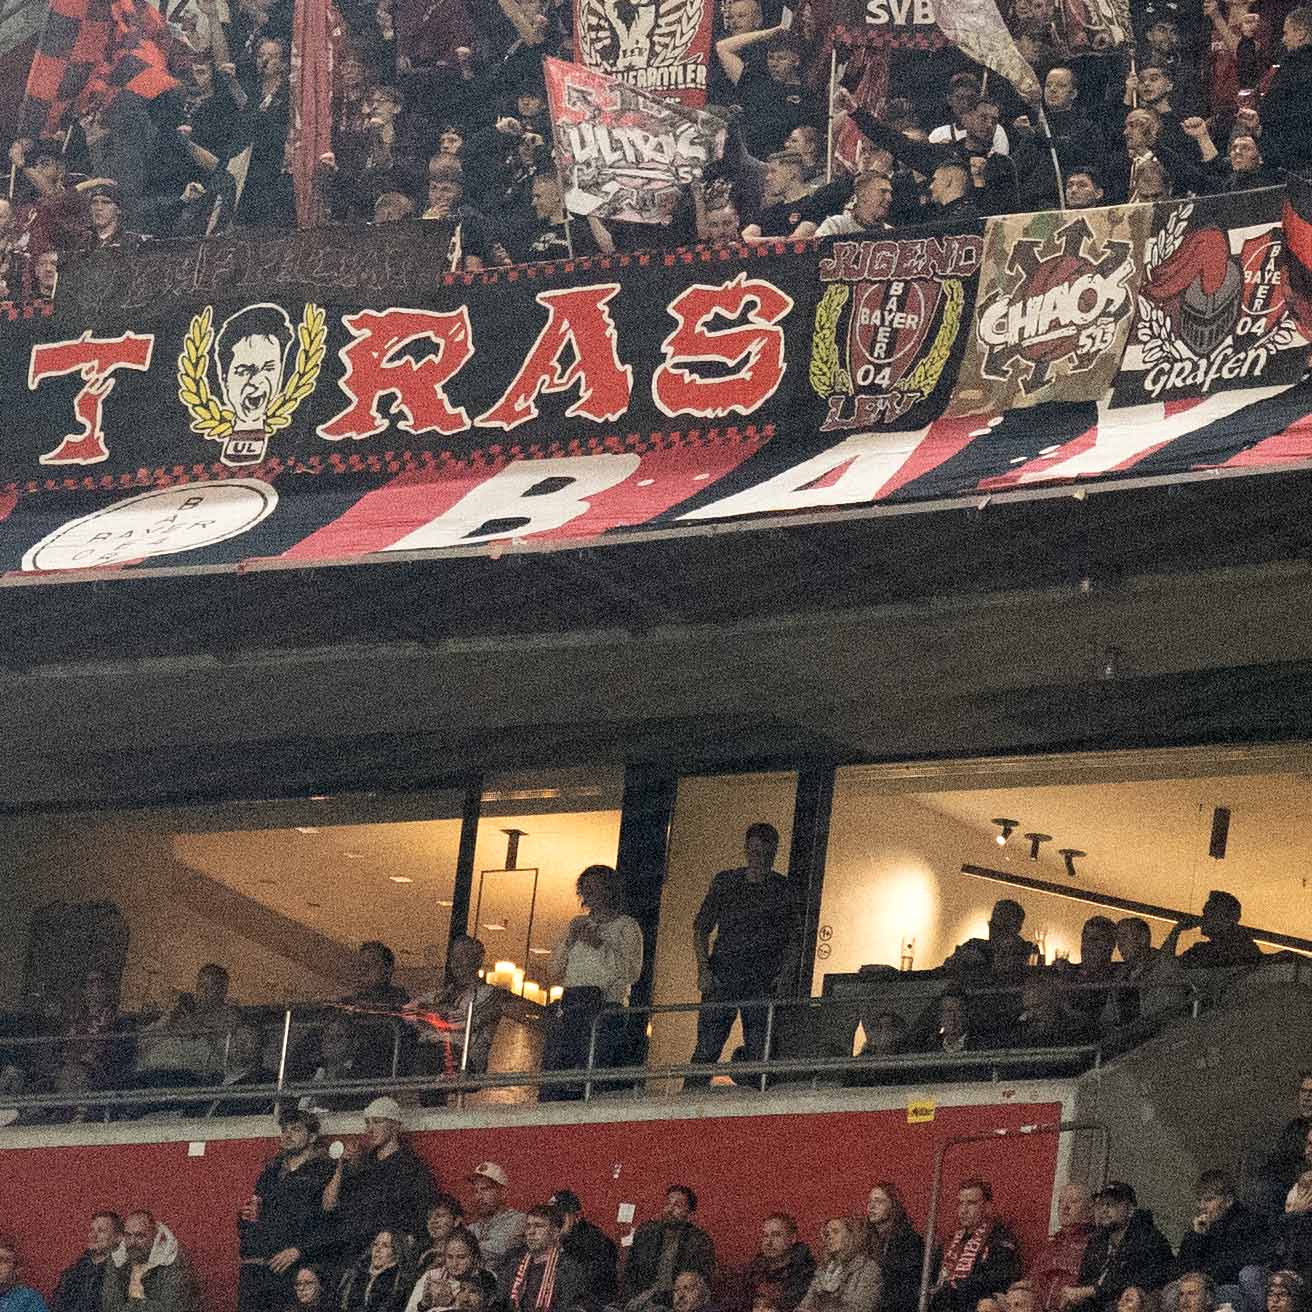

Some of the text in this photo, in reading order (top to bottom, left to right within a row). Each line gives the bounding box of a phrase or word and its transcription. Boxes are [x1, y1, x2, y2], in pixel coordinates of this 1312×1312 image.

[819, 235, 985, 281] JUGEND
[1244, 270, 1281, 285] BAYE
[979, 258, 1135, 347] CHAOS
[860, 307, 920, 329] BAYER
[873, 281, 905, 359] BAYER
[1236, 315, 1267, 337] 04
[856, 364, 892, 388] 04
